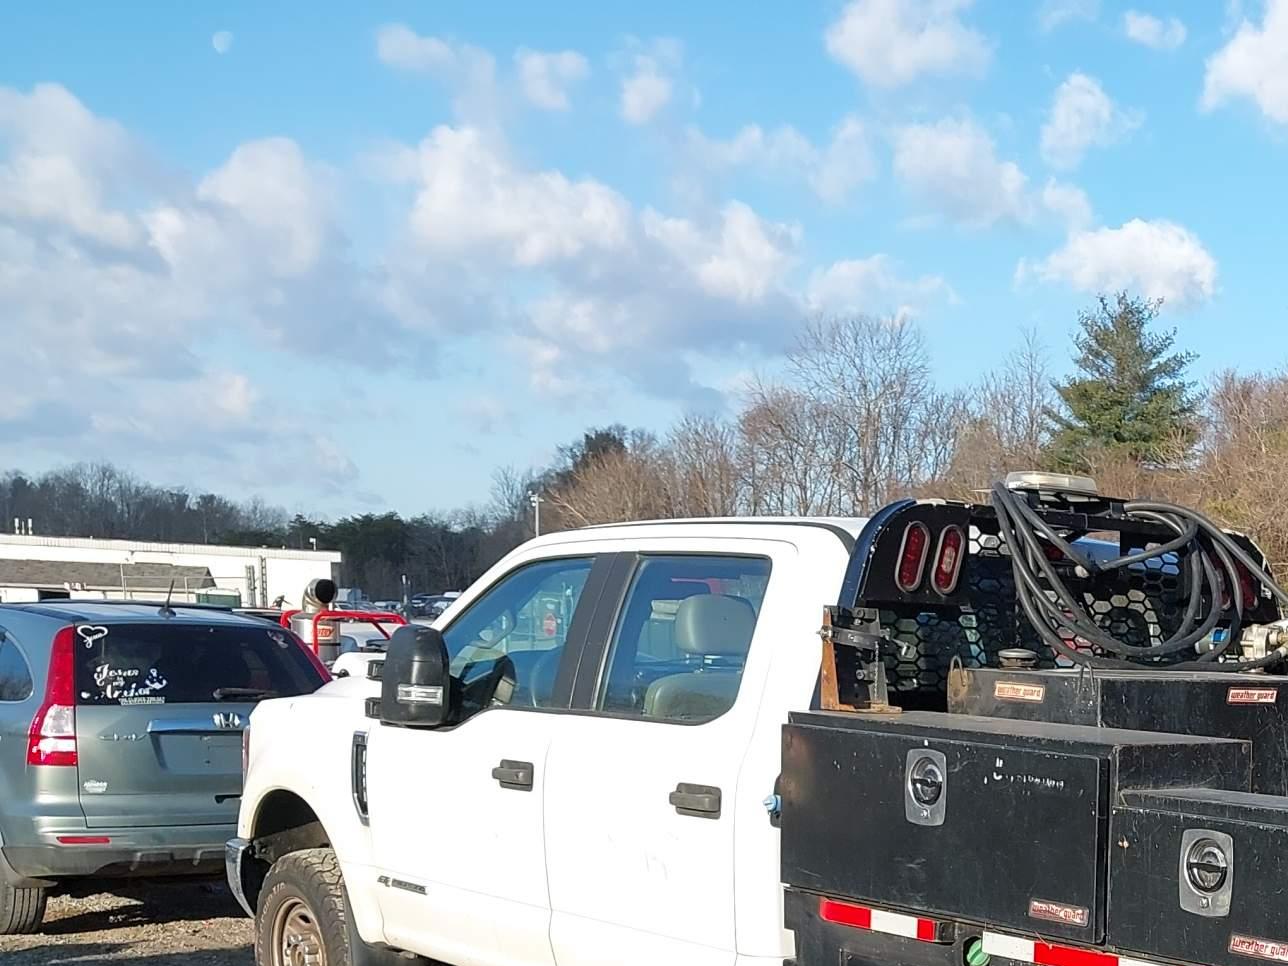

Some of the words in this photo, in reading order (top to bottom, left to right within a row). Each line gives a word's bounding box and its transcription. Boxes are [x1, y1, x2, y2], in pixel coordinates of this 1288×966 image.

[1231, 690, 1256, 699] weather
[1032, 903, 1060, 915] weather
[1063, 909, 1085, 921] guard
[1232, 937, 1268, 953] weather
